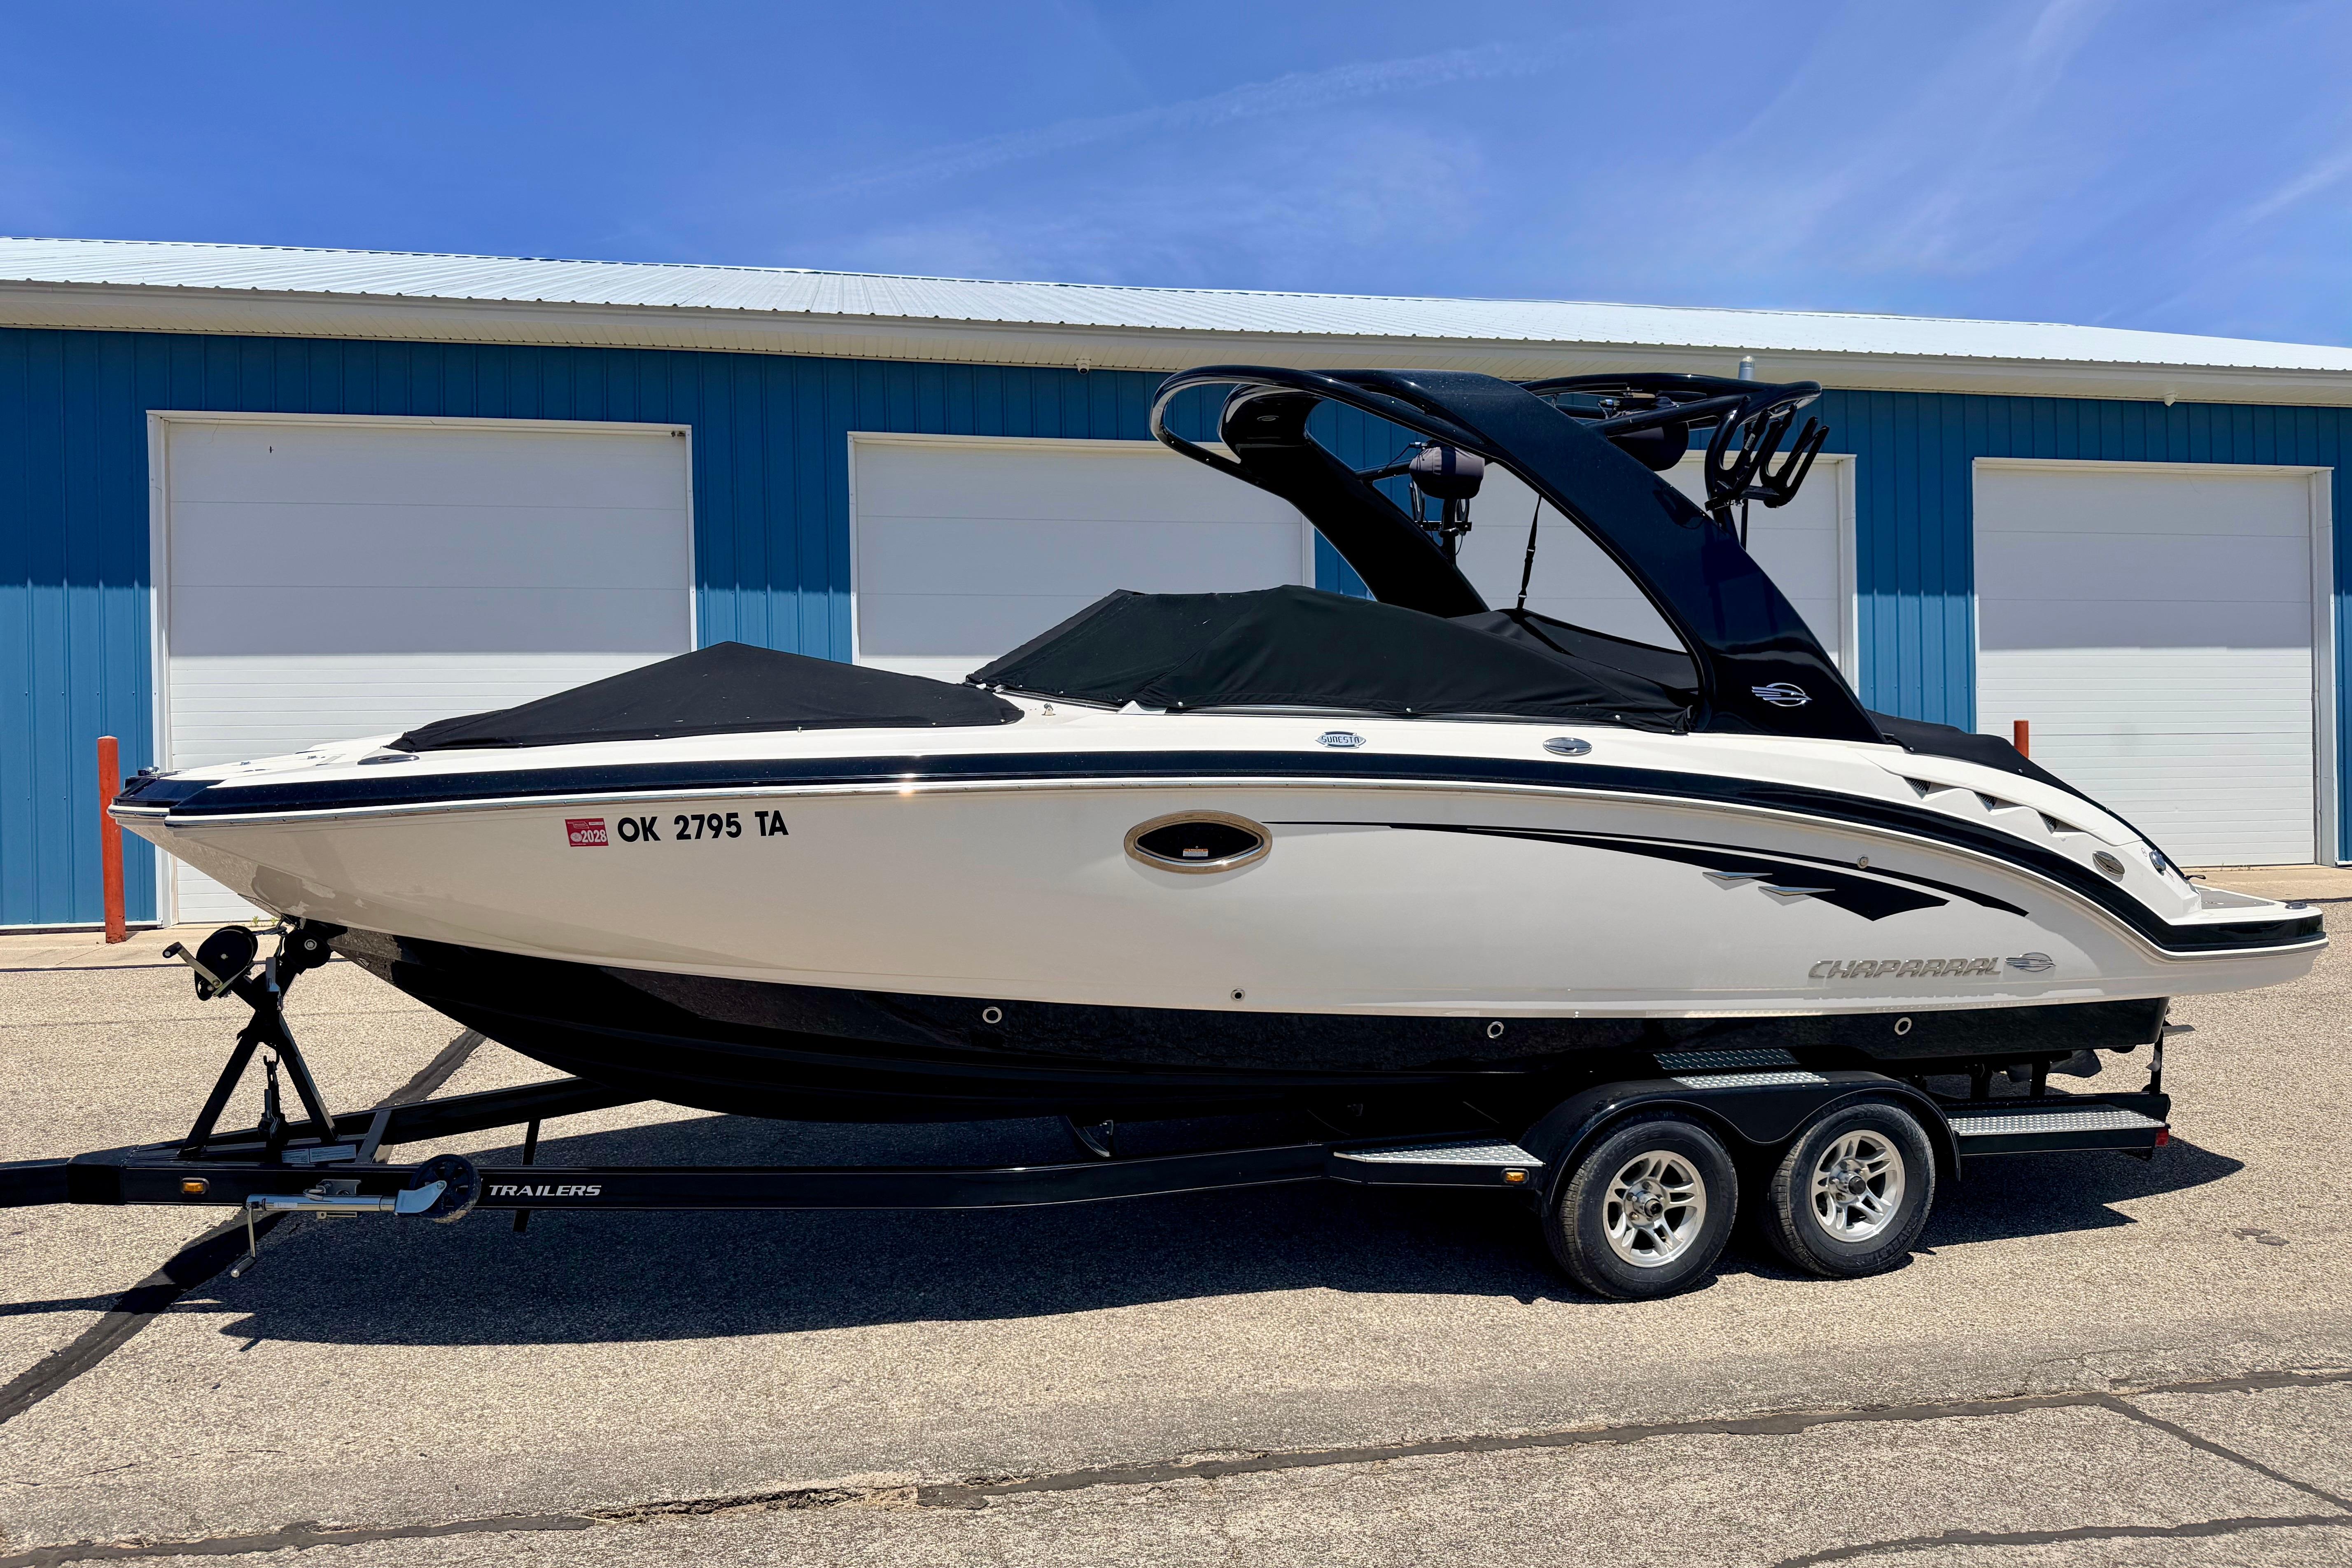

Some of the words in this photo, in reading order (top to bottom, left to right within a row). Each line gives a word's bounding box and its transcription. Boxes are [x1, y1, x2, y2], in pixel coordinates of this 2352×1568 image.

[618, 816, 661, 842] OK
[674, 812, 742, 840] 2795
[755, 810, 789, 836] TA
[581, 830, 607, 842] 2028
[1808, 958, 2001, 978] CHAPARRAL
[489, 1185, 601, 1196] TRAILERS
